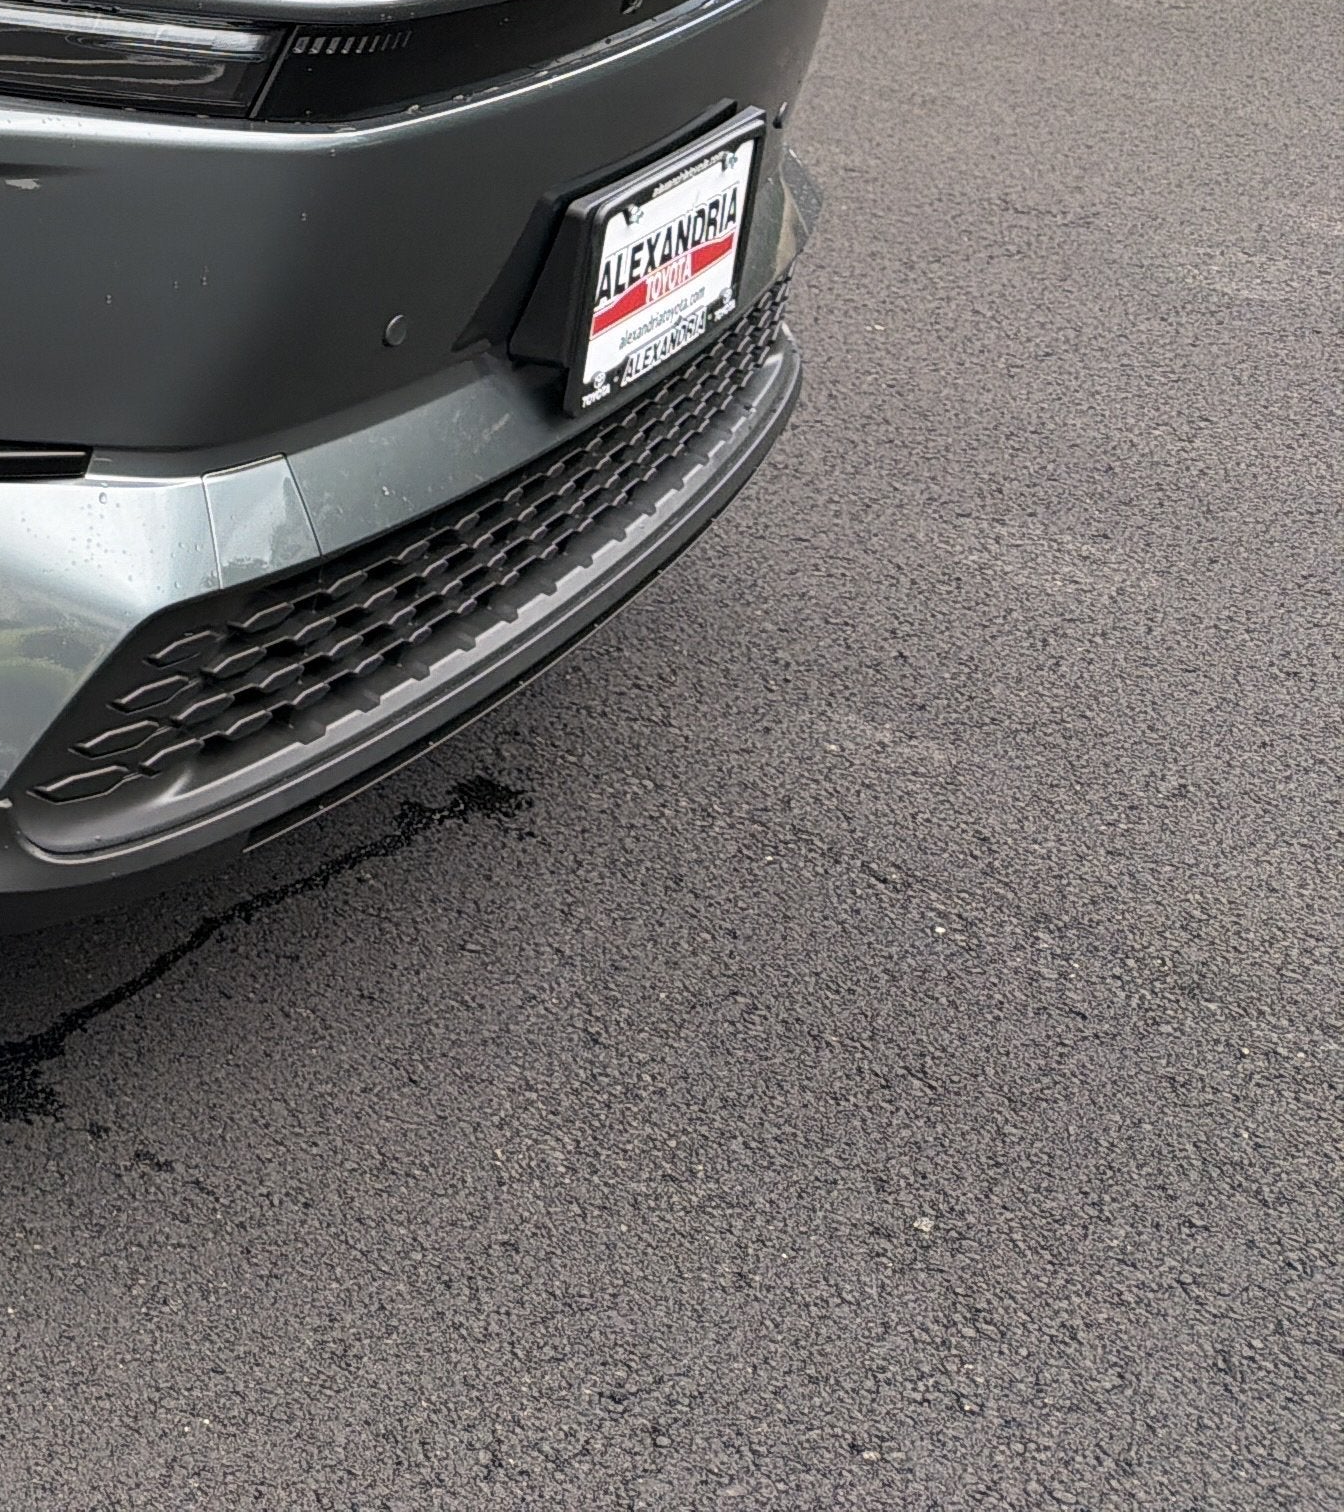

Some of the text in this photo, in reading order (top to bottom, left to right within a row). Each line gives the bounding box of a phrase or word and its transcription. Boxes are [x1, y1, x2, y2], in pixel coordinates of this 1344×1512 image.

[594, 186, 738, 304] ALEXANDRIA
[645, 254, 693, 304] TOYOTA
[618, 285, 707, 351] alexandriatoyota.com
[620, 306, 709, 388] ALEXANDRIA
